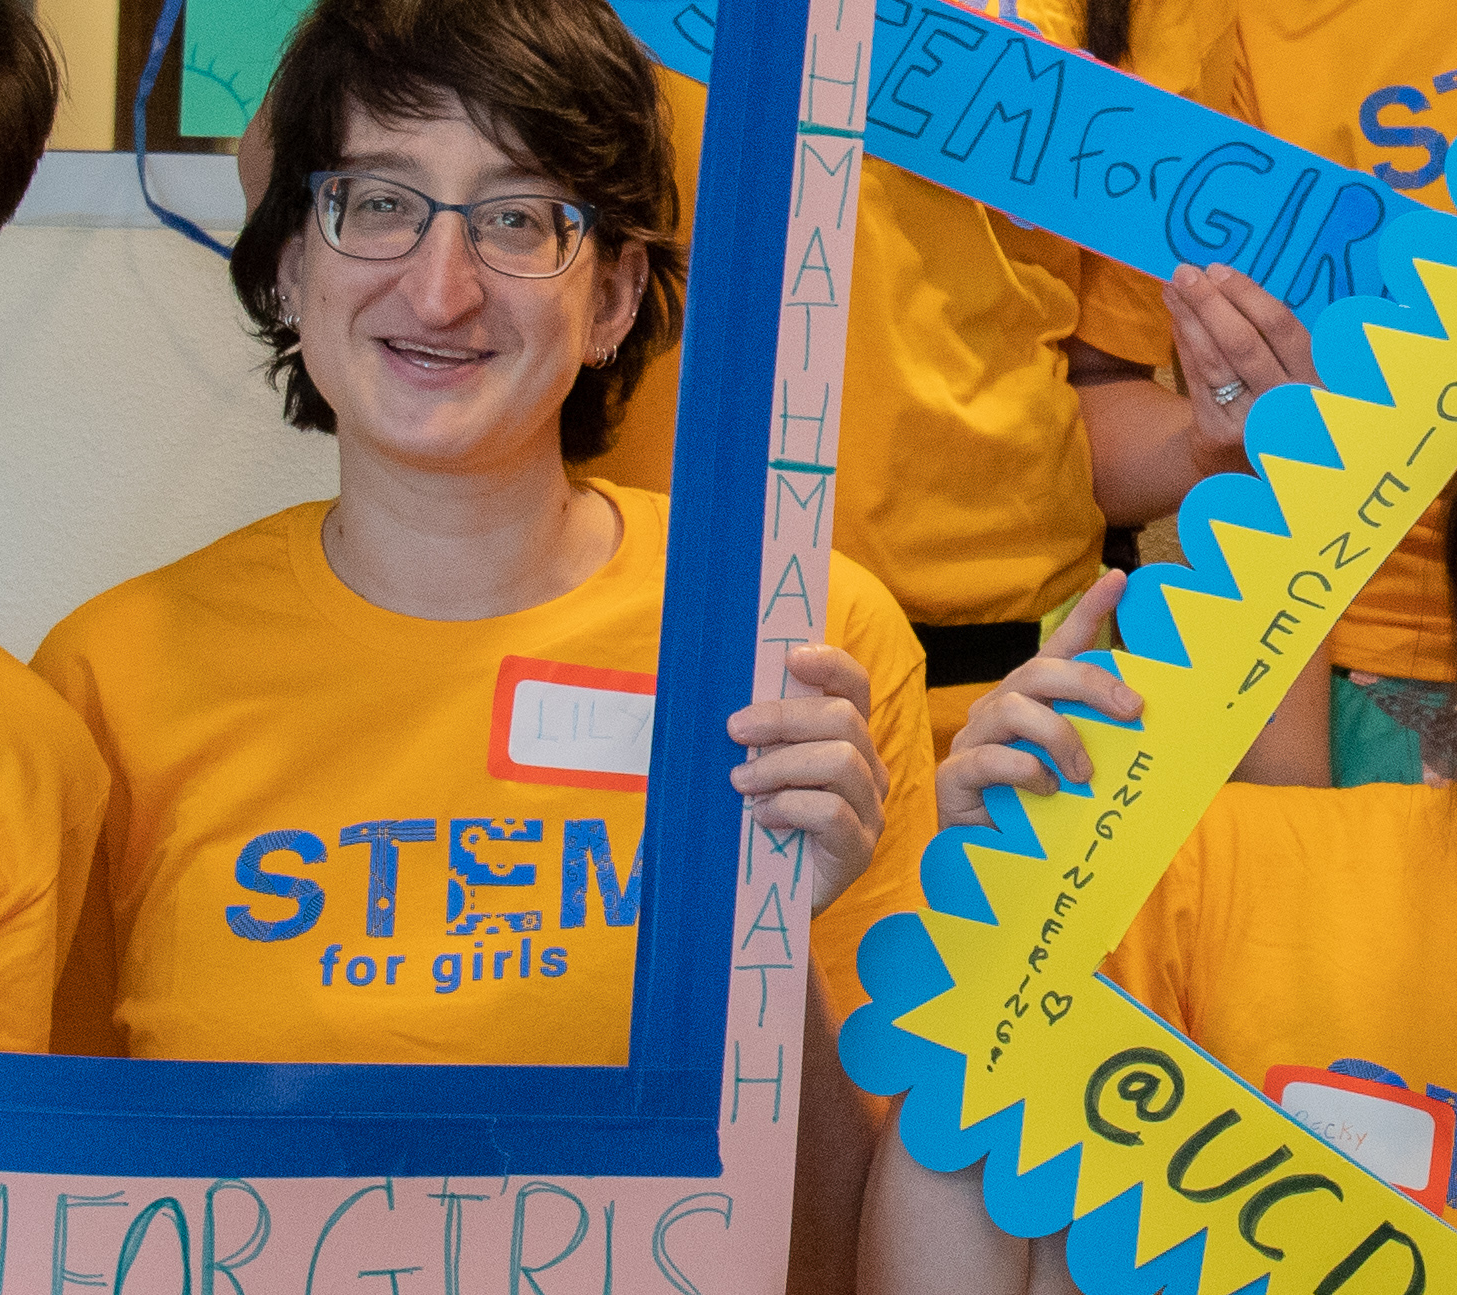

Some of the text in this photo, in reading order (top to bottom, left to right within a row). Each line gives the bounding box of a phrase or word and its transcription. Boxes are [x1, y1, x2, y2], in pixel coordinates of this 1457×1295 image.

[779, 141, 855, 463] MATH
[1070, 107, 1181, 198] for
[1166, 142, 1392, 308] GIR
[762, 473, 826, 704] MAT
[225, 818, 643, 943] STEM
[320, 938, 569, 993] for girls
